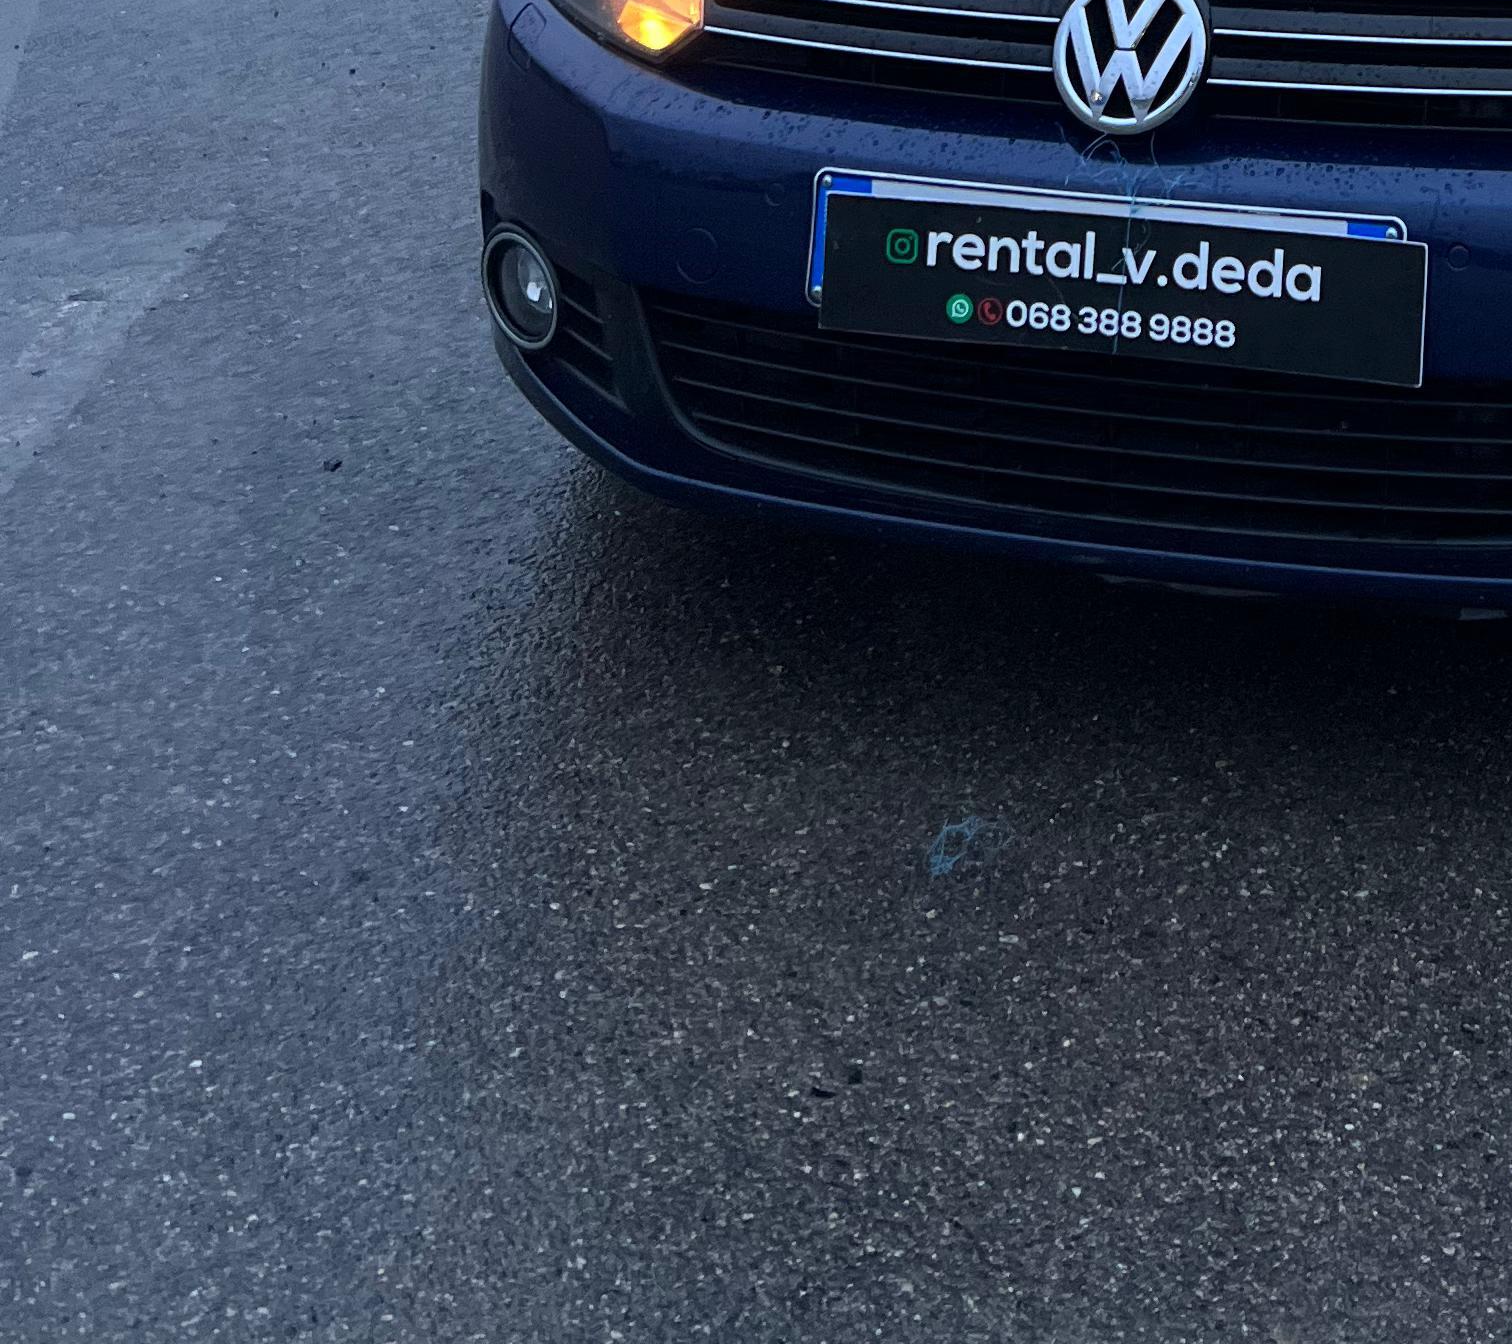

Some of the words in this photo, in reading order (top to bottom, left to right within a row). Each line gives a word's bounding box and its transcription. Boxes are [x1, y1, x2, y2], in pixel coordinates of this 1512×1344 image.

[925, 229, 1323, 303] rental_v.deda
[1005, 298, 1073, 333] 068
[1077, 305, 1143, 339] 388
[1148, 312, 1237, 349] 9888
